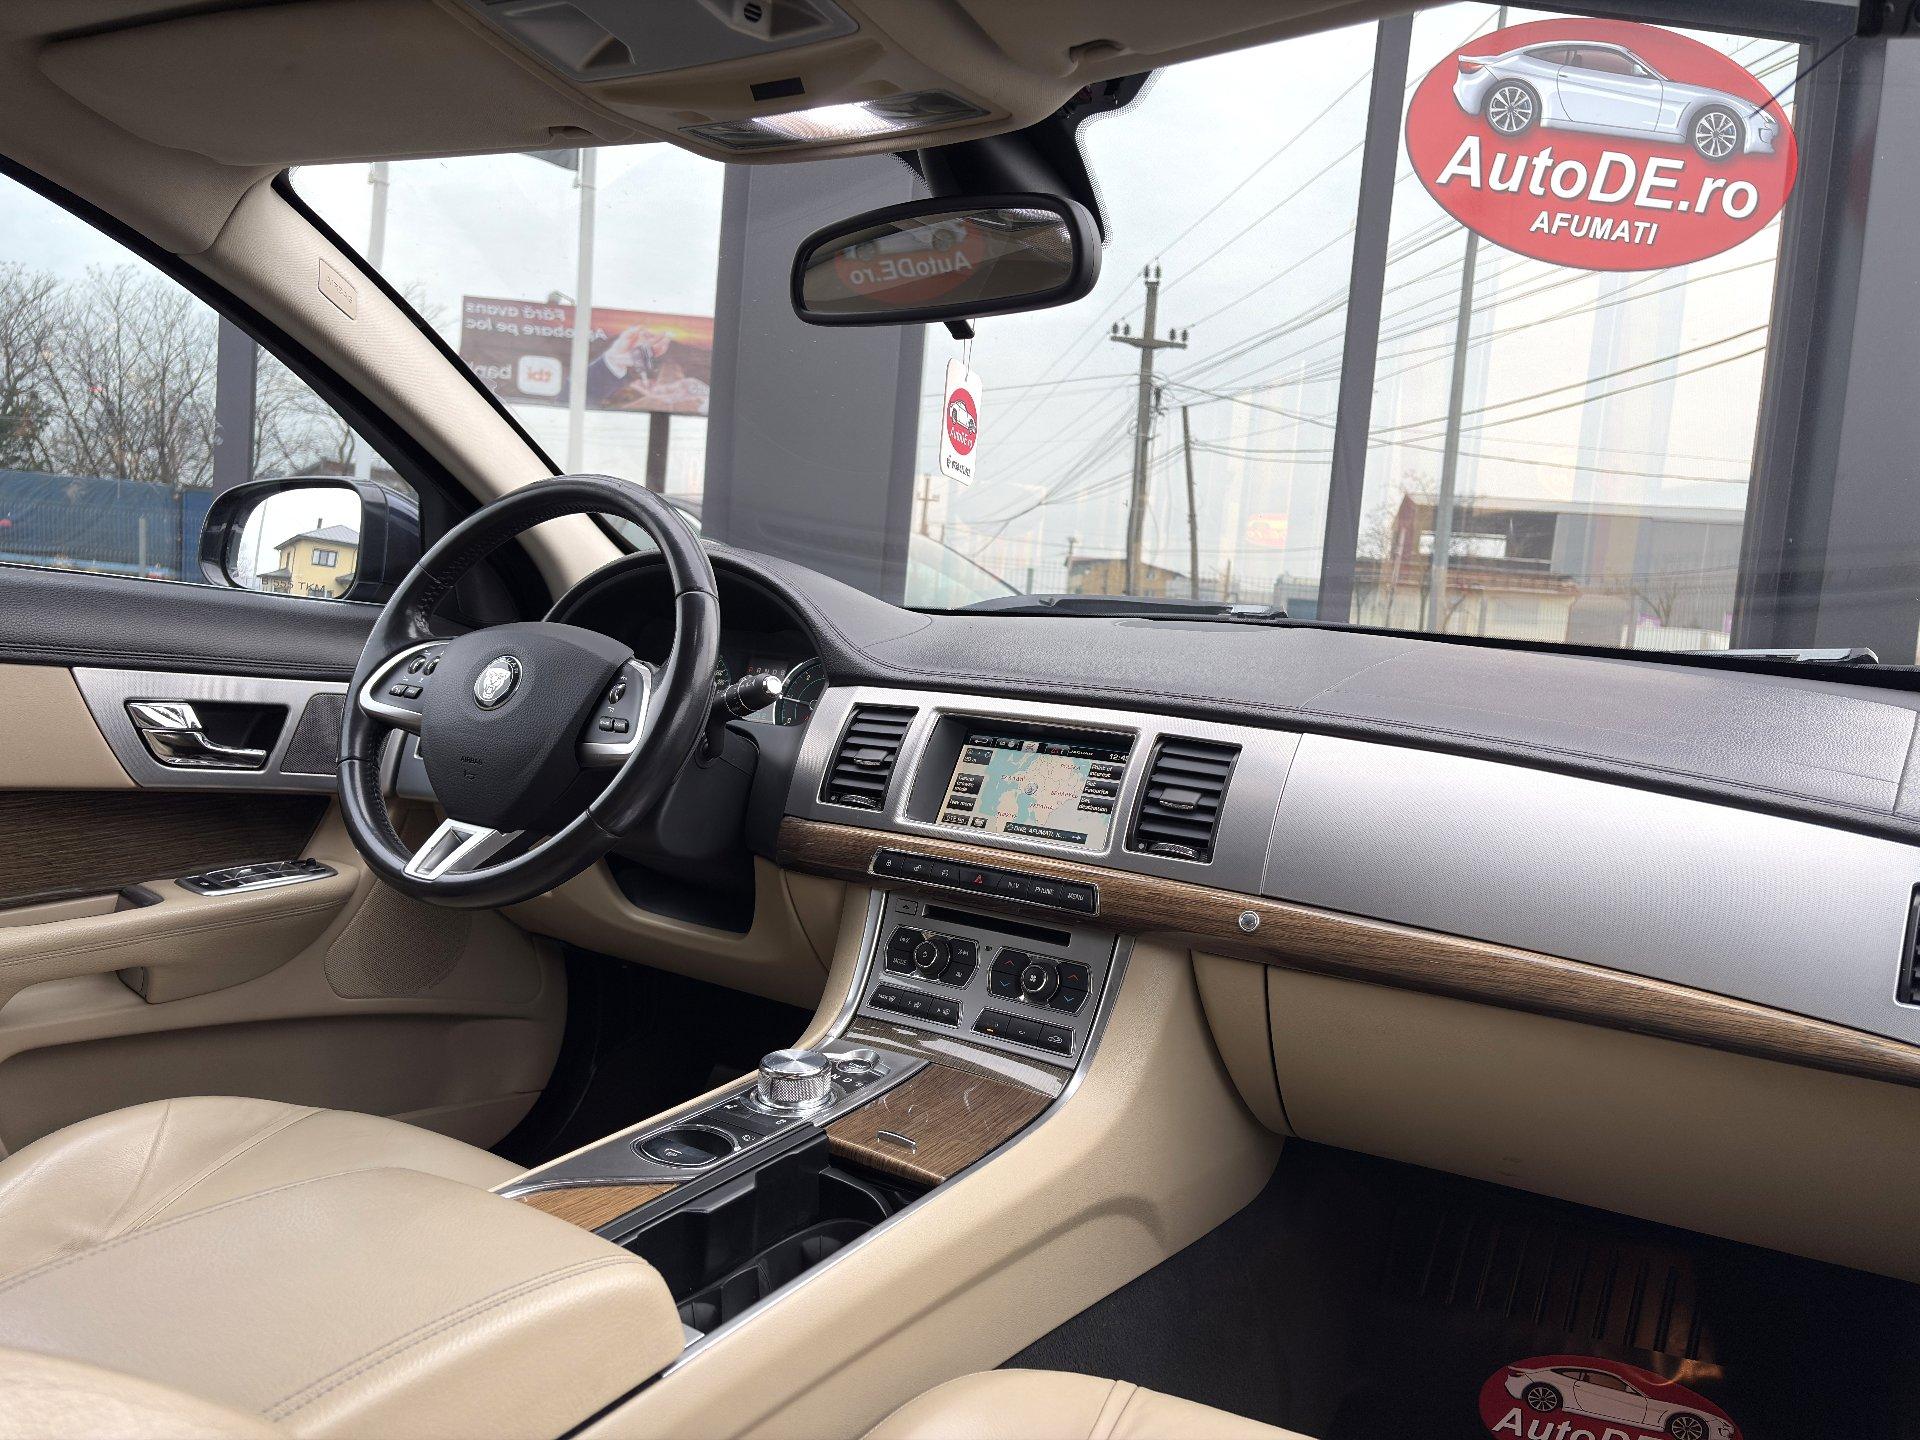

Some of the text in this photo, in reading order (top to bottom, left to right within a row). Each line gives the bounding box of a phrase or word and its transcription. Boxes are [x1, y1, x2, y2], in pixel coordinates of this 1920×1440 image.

[1437, 135, 1760, 220] AutoDE.ro
[1529, 210, 1659, 245] AFUMATI
[1067, 892, 1085, 902] MENU
